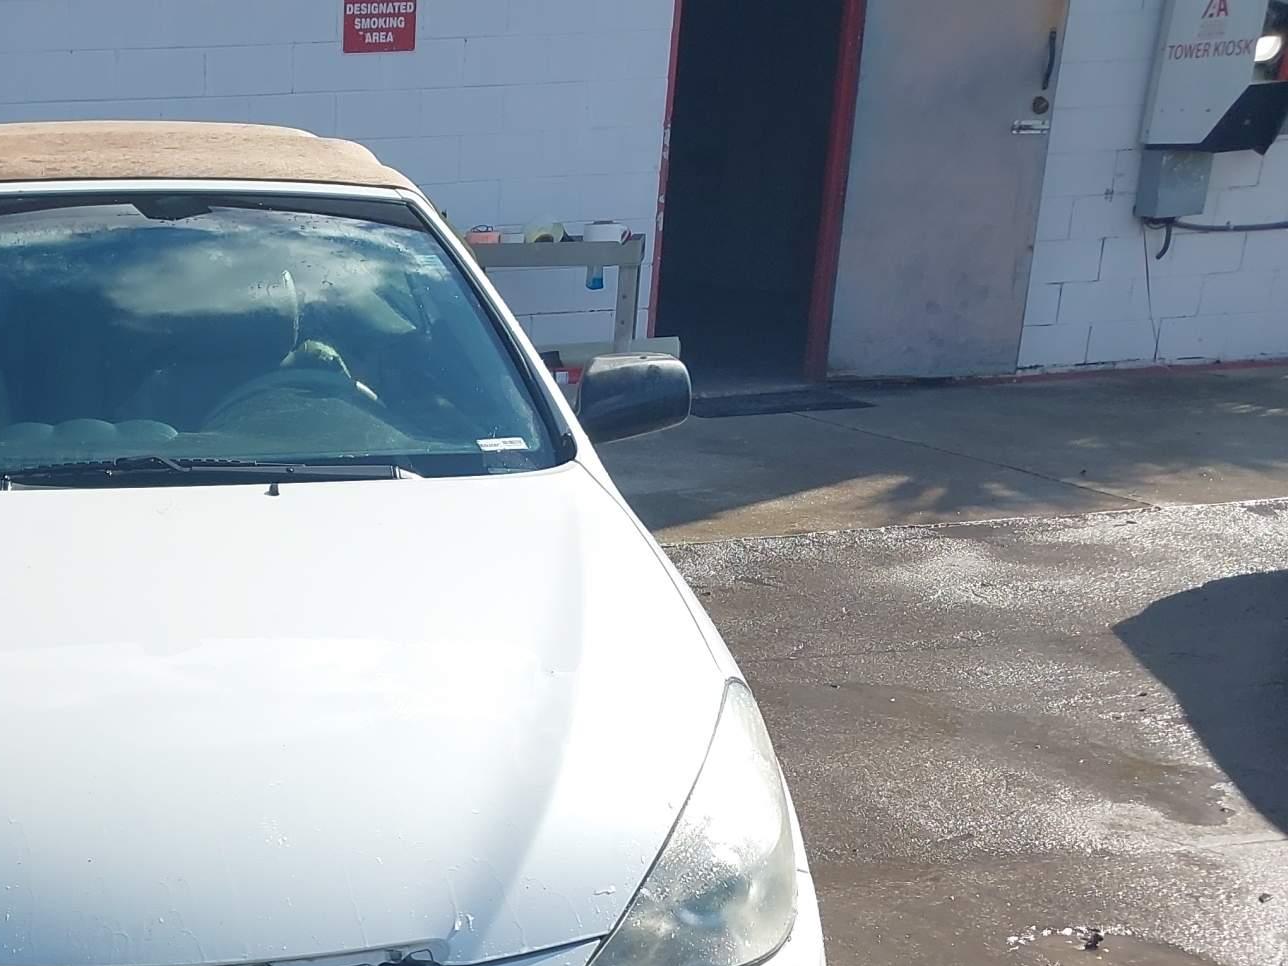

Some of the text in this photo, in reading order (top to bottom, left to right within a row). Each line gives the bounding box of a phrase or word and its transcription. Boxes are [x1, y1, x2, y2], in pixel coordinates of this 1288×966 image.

[346, 2, 415, 14] DESIGNATED
[354, 17, 405, 29] SMOKING
[365, 32, 394, 43] AREA
[1168, 39, 1254, 60] TOWER KIOSK
